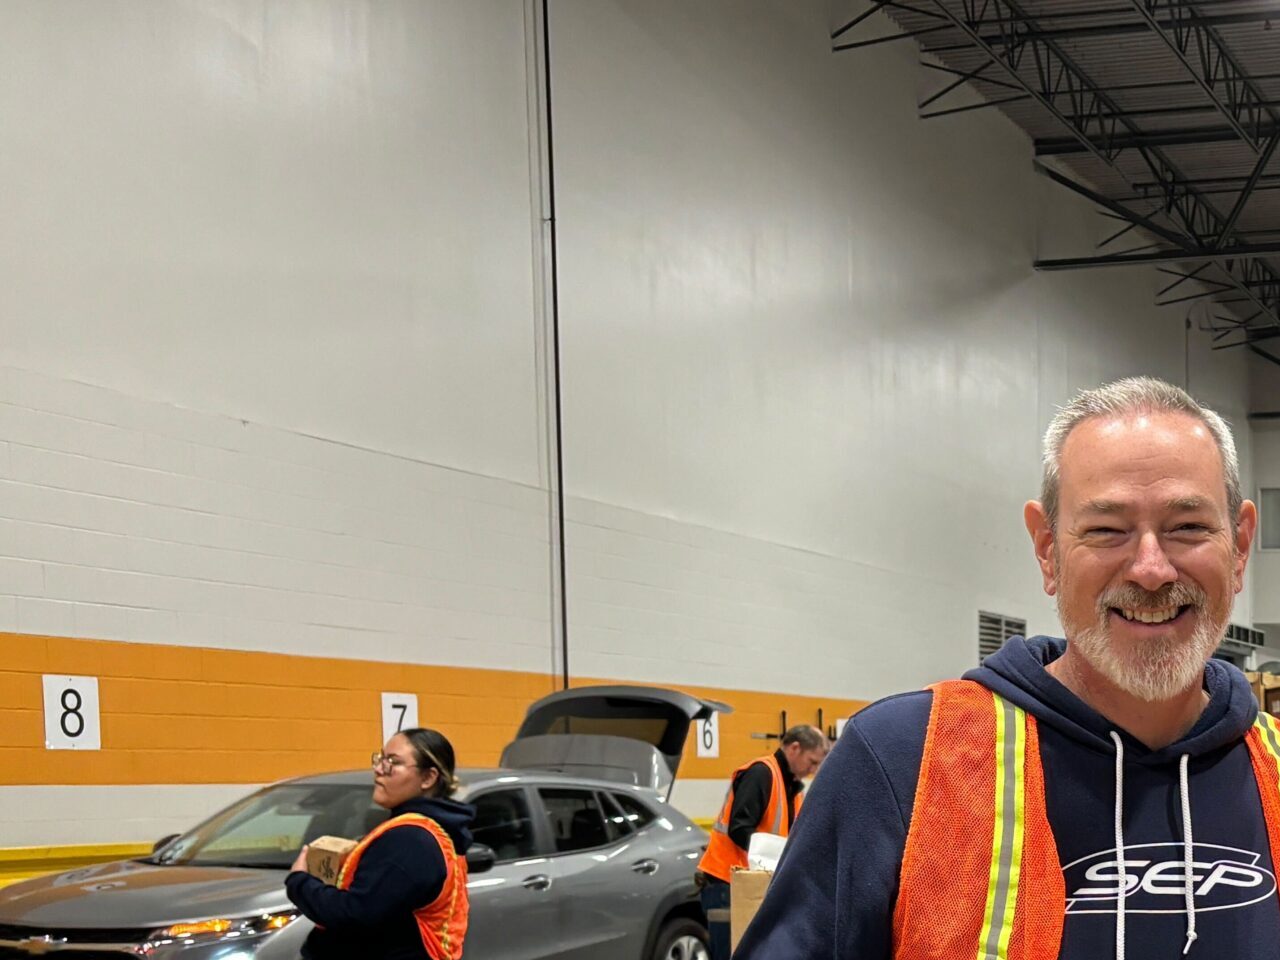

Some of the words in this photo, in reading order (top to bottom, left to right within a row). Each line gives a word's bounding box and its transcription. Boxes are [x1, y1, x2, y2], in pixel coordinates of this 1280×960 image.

[60, 688, 85, 738] 8
[392, 704, 407, 733] 7
[703, 719, 713, 750] 6
[1073, 860, 1263, 896] SEP
